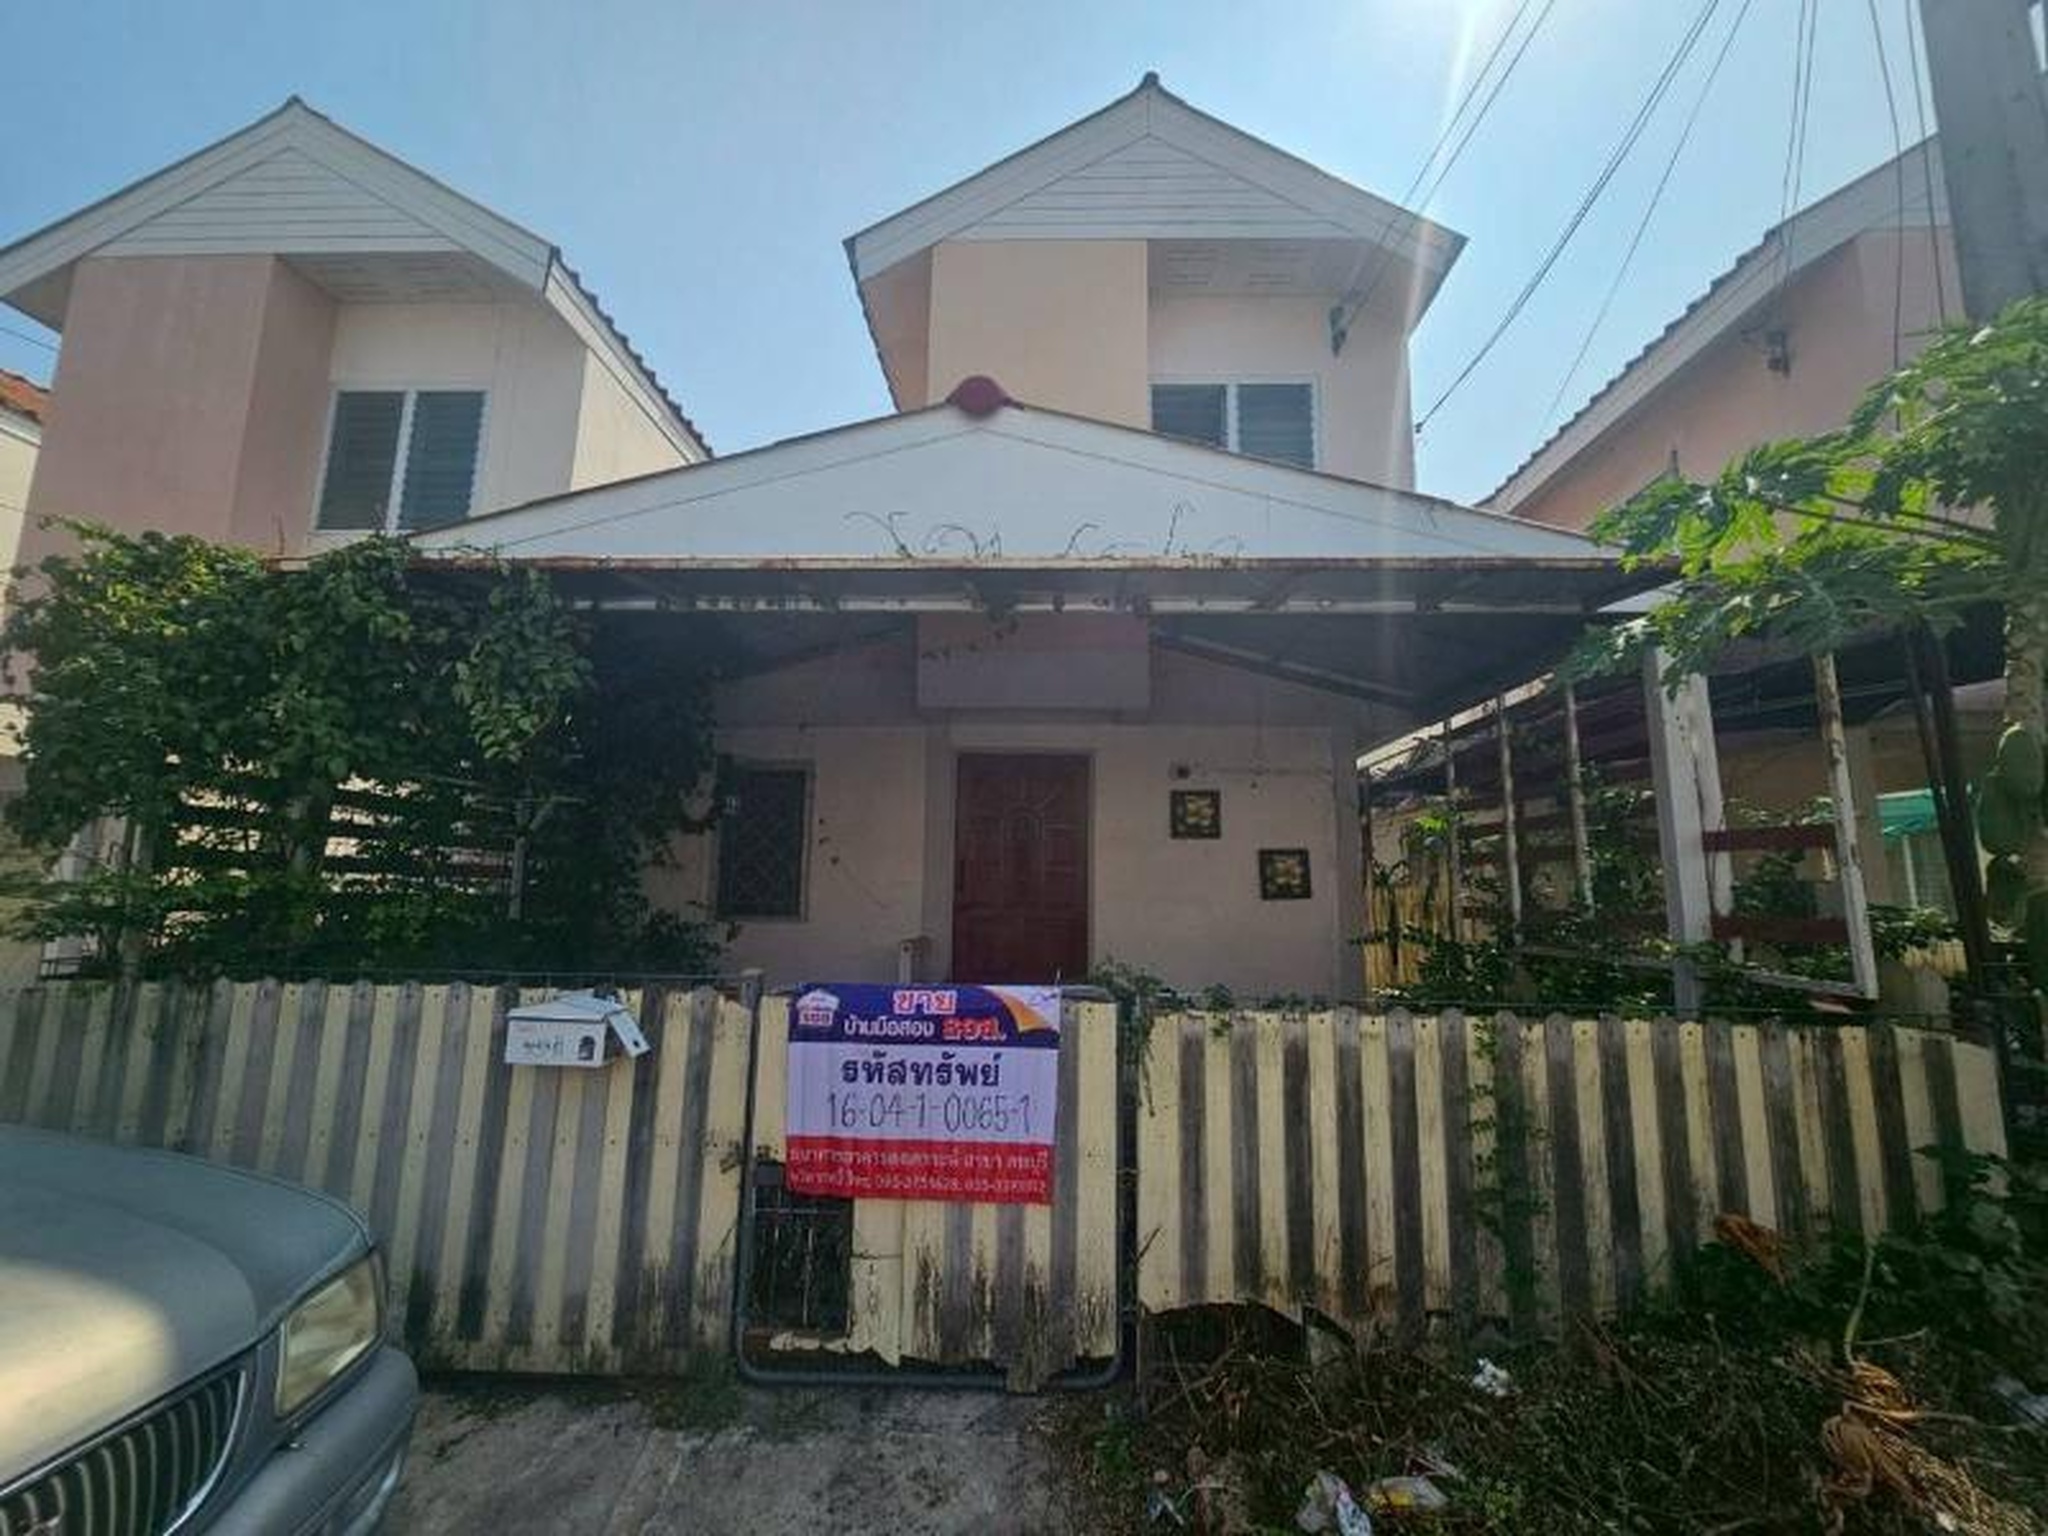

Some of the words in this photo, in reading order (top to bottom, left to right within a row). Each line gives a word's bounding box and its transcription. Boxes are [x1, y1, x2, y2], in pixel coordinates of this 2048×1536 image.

[893, 990, 957, 1015] ขาย
[843, 1014, 934, 1040] บ้านมือสอง
[842, 1050, 1001, 1087] รหัสทรัพย์
